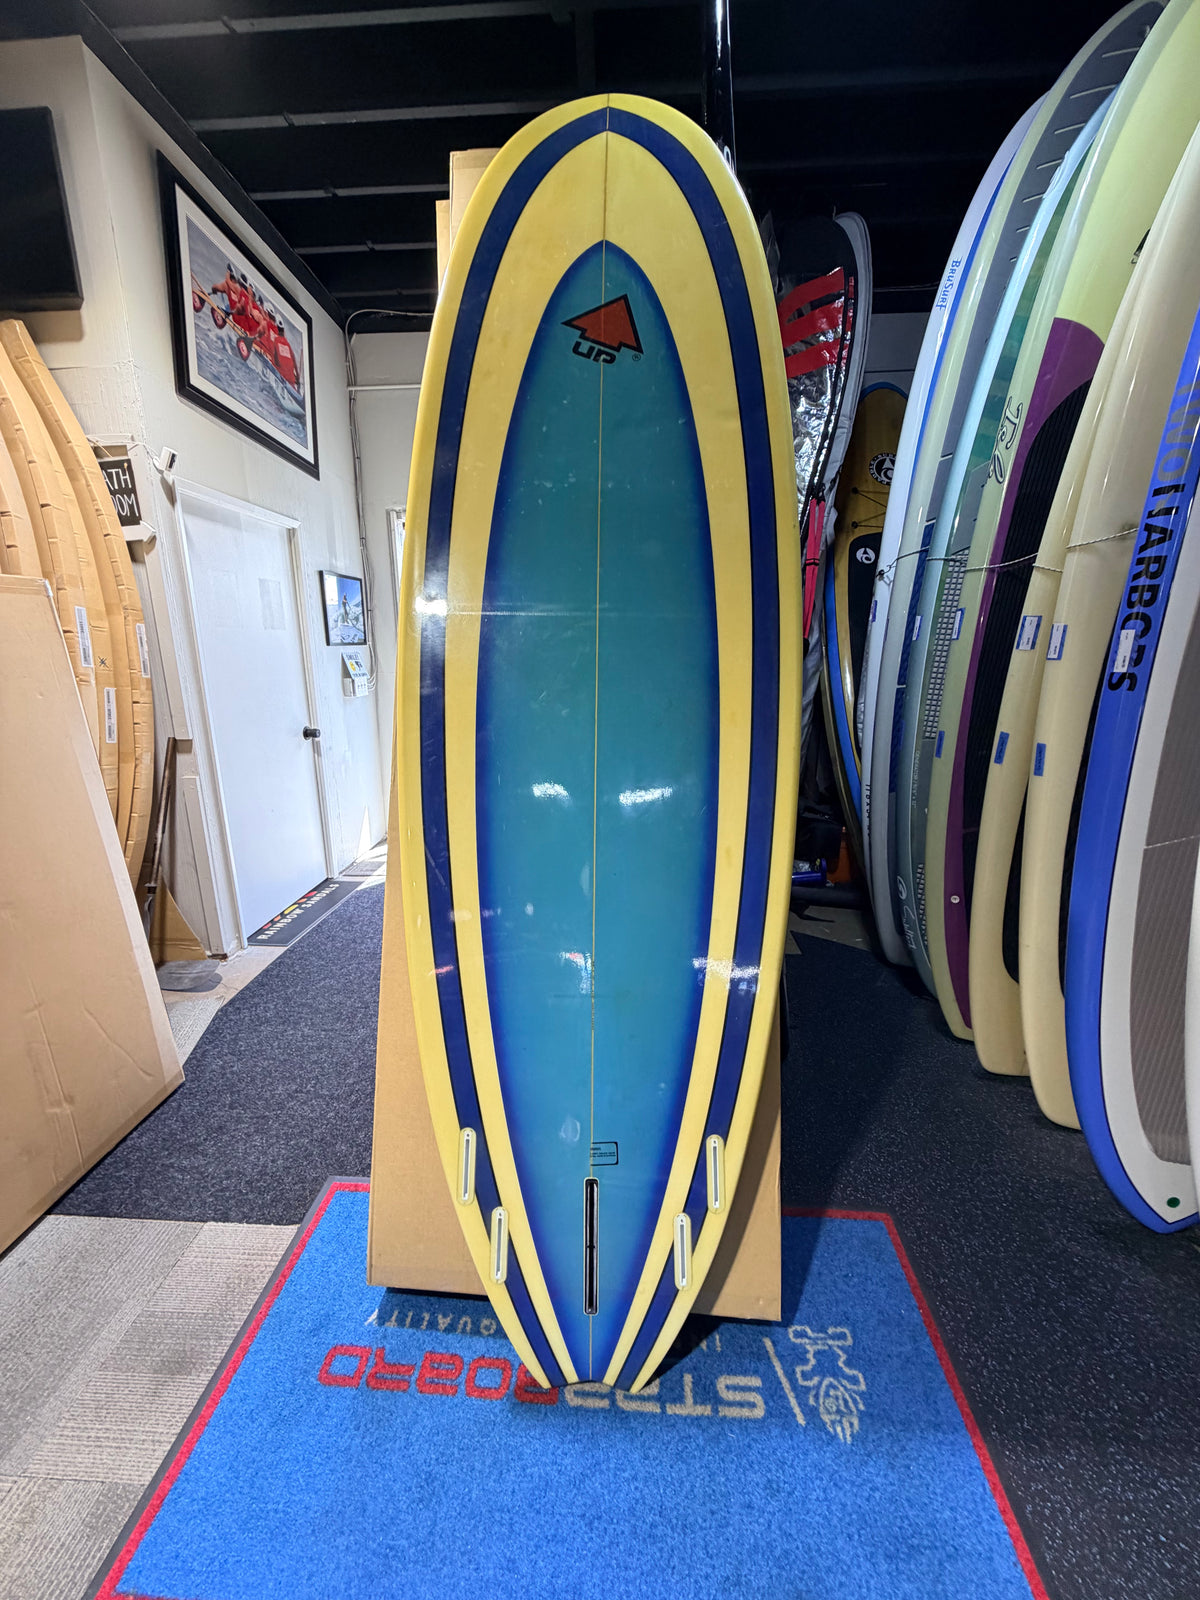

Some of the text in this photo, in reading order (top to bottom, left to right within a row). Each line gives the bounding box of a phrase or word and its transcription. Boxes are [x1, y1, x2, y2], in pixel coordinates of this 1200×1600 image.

[572, 341, 617, 365] UP
[102, 468, 132, 490] ATH
[111, 493, 139, 517] OOM
[256, 883, 340, 940] RAINBOW SANDALS
[364, 1308, 498, 1335] QUALITY
